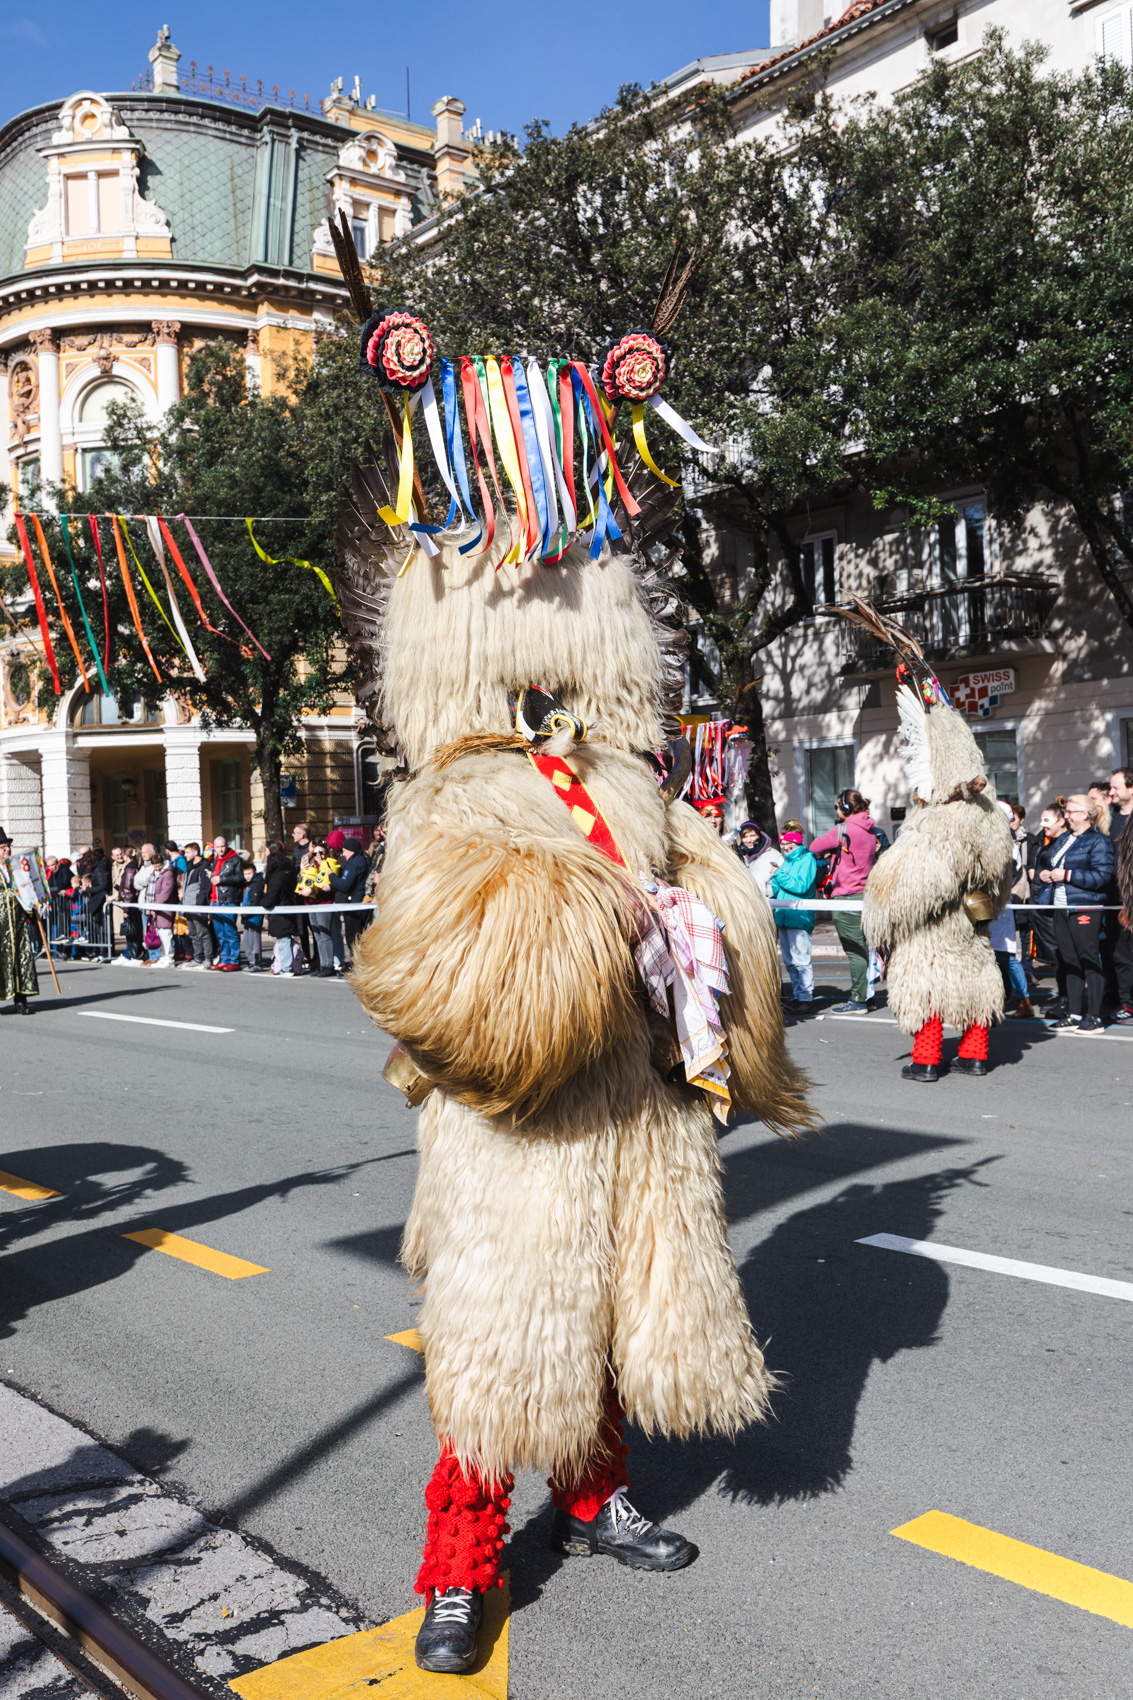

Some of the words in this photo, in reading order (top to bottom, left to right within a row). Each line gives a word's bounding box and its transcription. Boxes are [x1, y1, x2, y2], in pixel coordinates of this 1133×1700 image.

[972, 671, 1011, 685] SWISS
[990, 682, 1014, 694] point
[20, 858, 31, 872] 8
